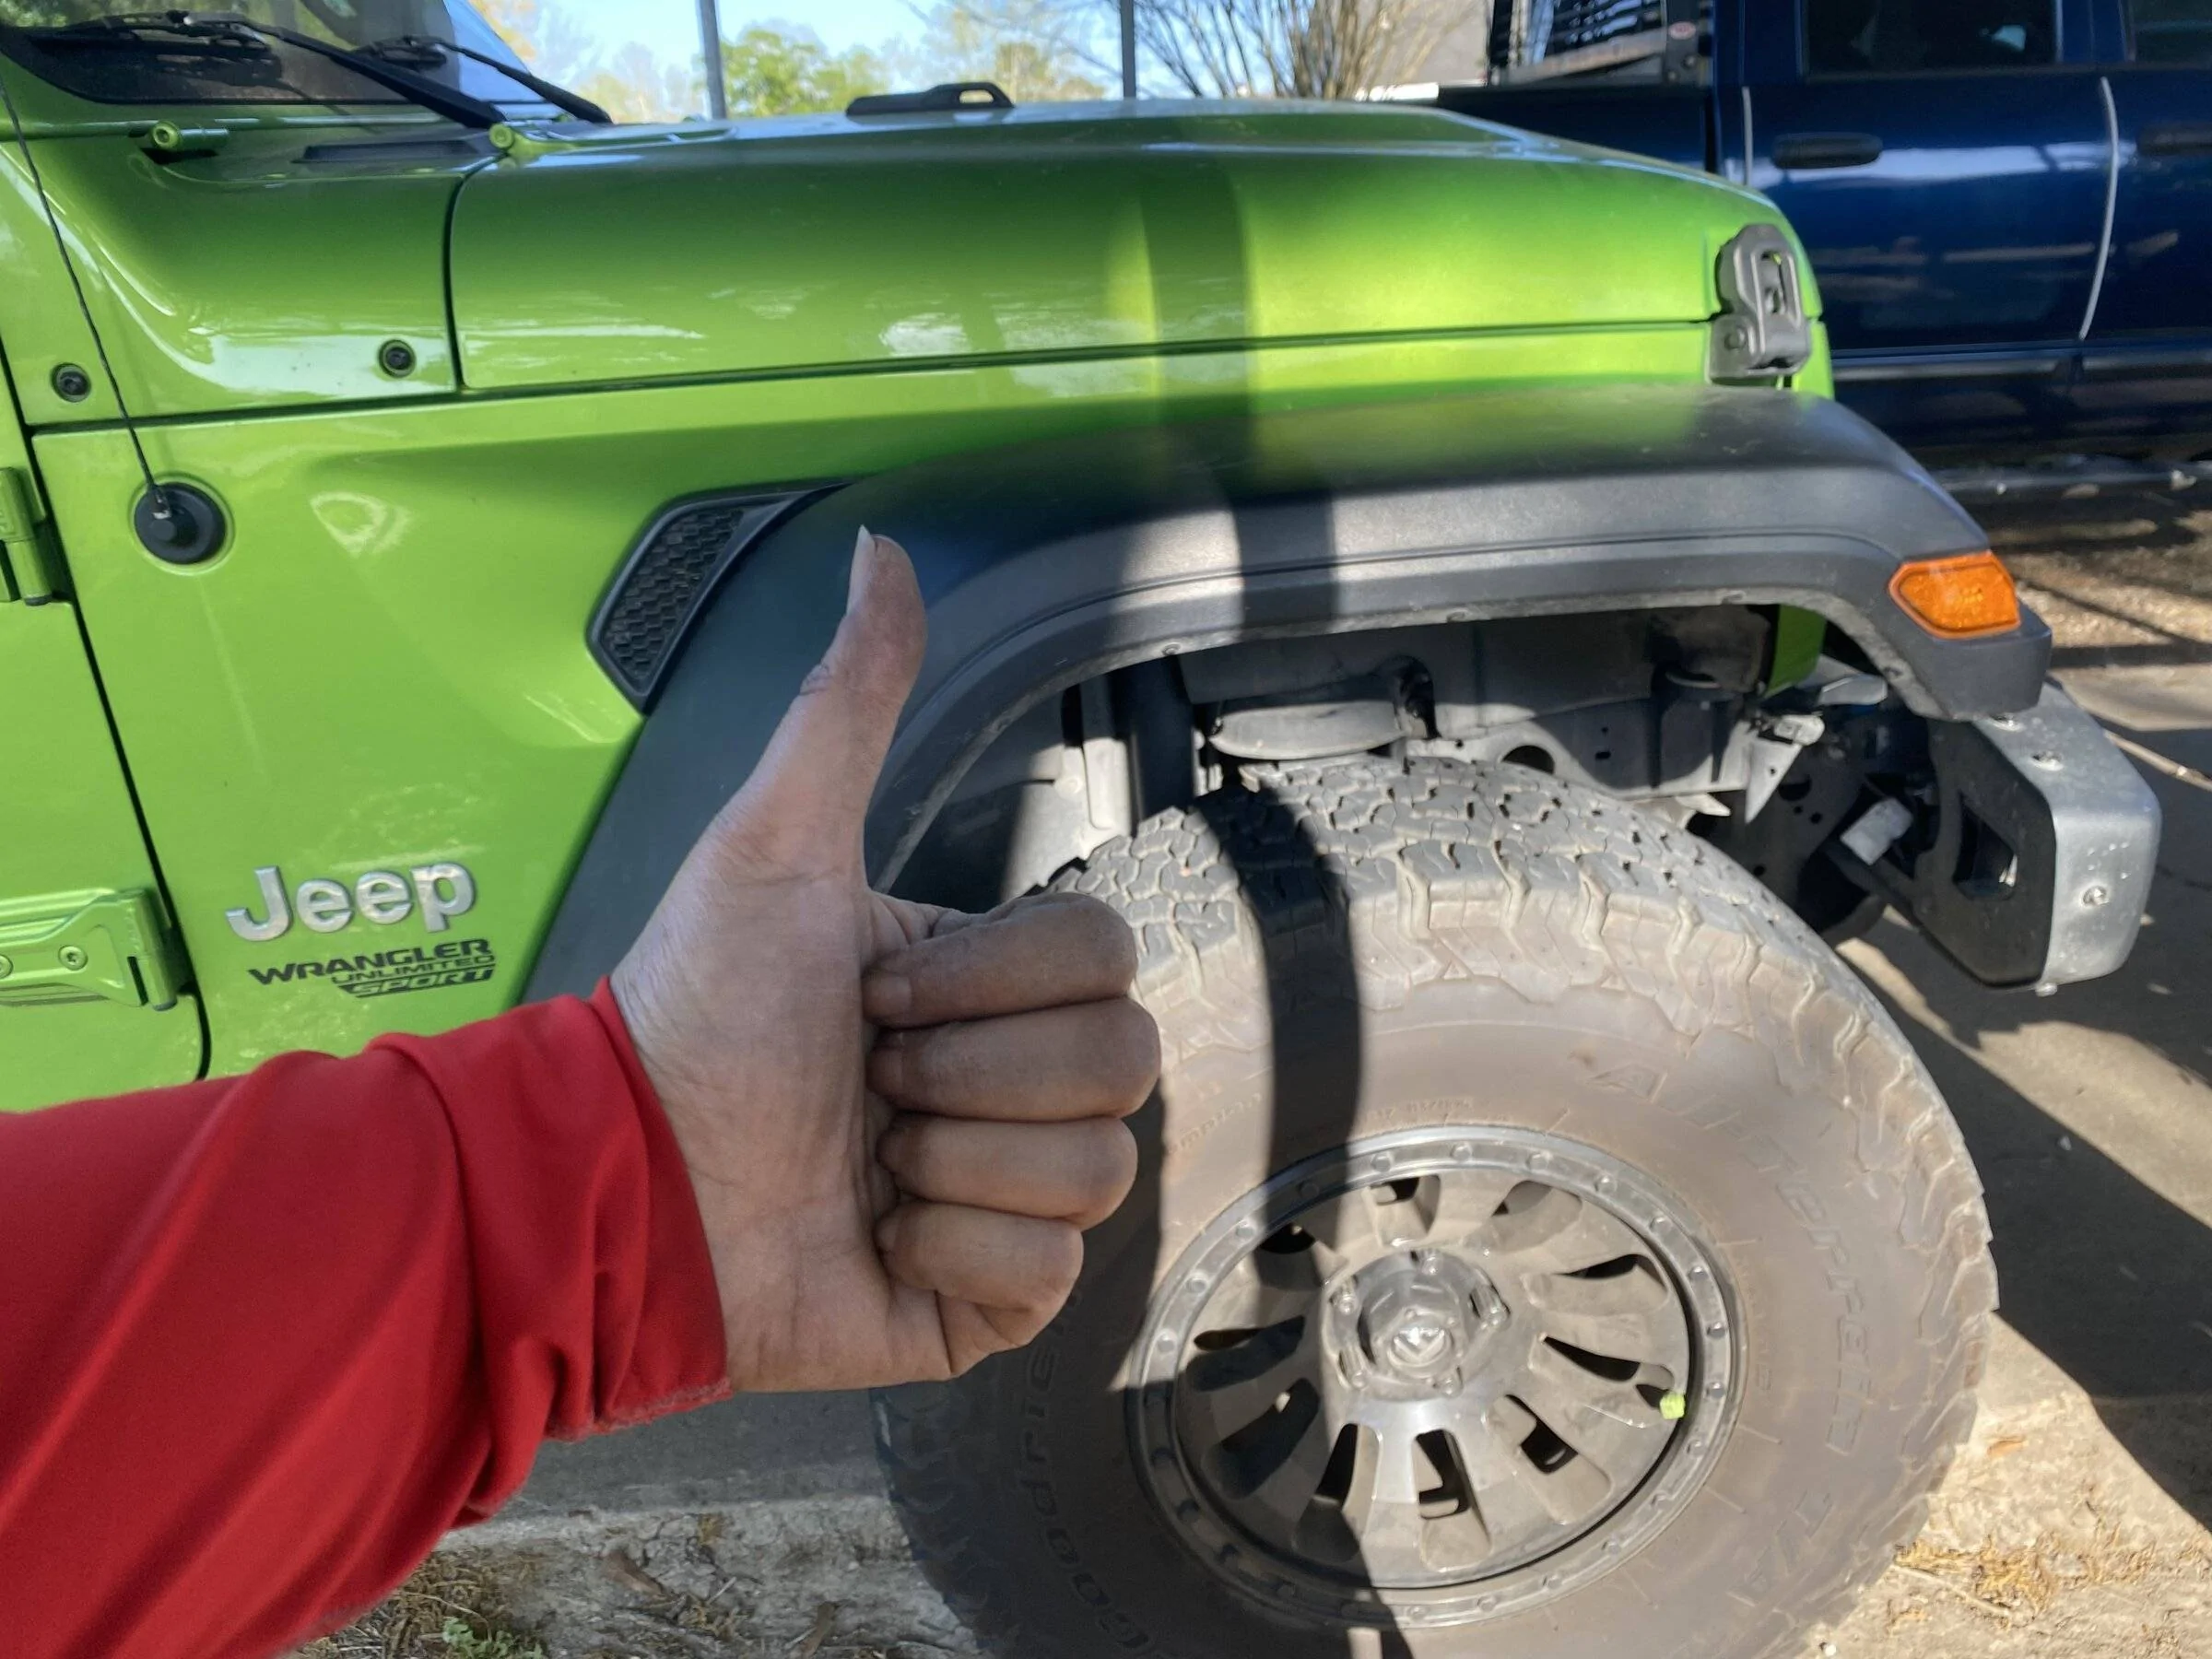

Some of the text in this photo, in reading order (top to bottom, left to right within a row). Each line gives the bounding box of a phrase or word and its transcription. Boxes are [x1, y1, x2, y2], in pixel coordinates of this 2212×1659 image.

[225, 861, 476, 941] Jeep
[247, 938, 492, 985] WRANGLER
[331, 955, 496, 983] UNLIMITED
[354, 969, 490, 995] SPORT
